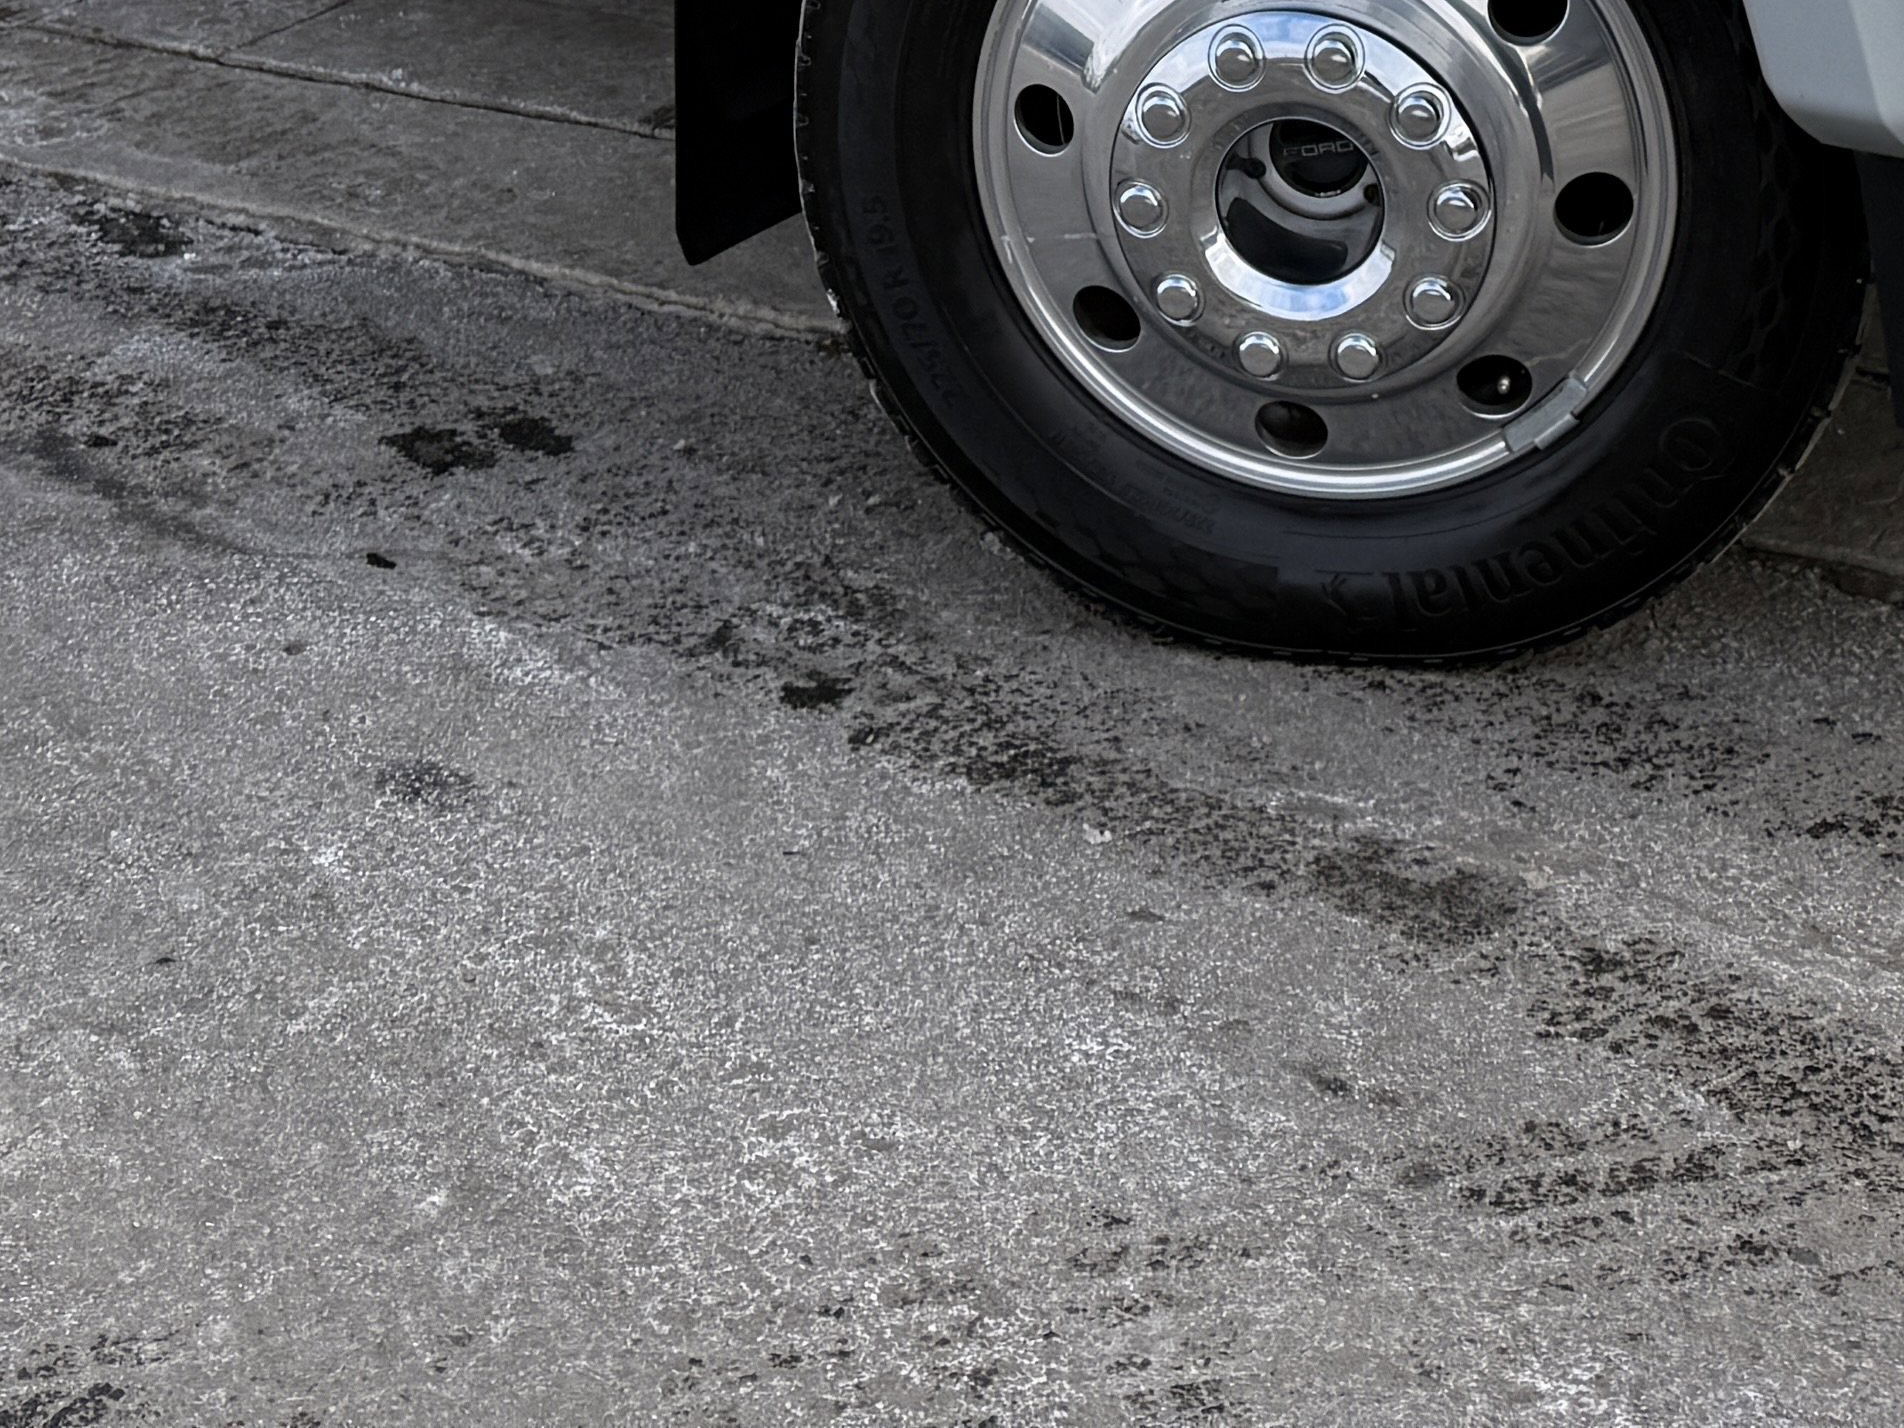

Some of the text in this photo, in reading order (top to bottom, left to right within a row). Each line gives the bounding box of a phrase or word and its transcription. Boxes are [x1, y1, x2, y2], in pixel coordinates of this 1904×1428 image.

[1283, 140, 1355, 157] FORD
[862, 195, 961, 408] 225/70 R 19.5
[1383, 415, 1732, 632] Continental
